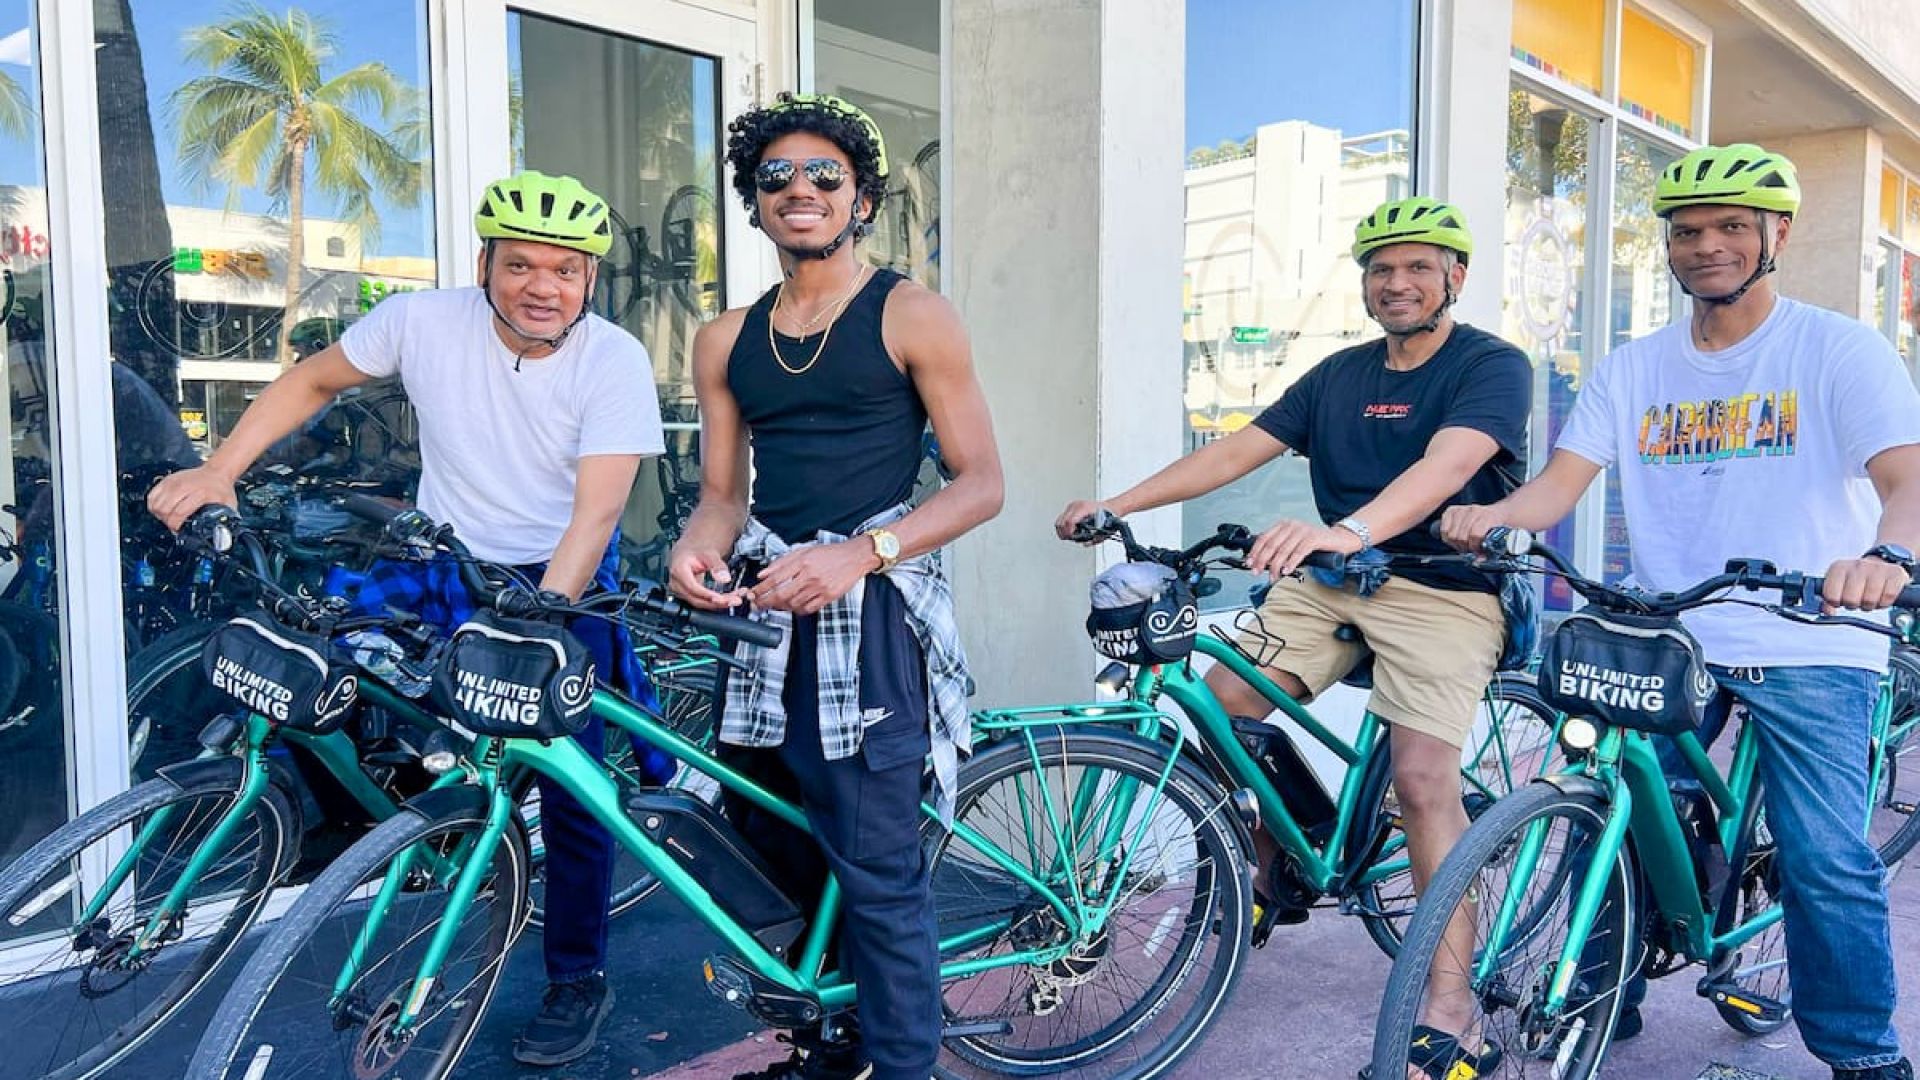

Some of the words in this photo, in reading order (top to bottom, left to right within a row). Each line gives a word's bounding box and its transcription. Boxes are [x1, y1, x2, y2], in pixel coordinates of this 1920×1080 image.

[1638, 388, 1798, 464] CARIBBEAN
[212, 669, 289, 721] BIKING
[216, 656, 294, 704] UNLIMITED
[1559, 673, 1665, 712] BIKING
[1561, 659, 1665, 690] UNLIMITED
